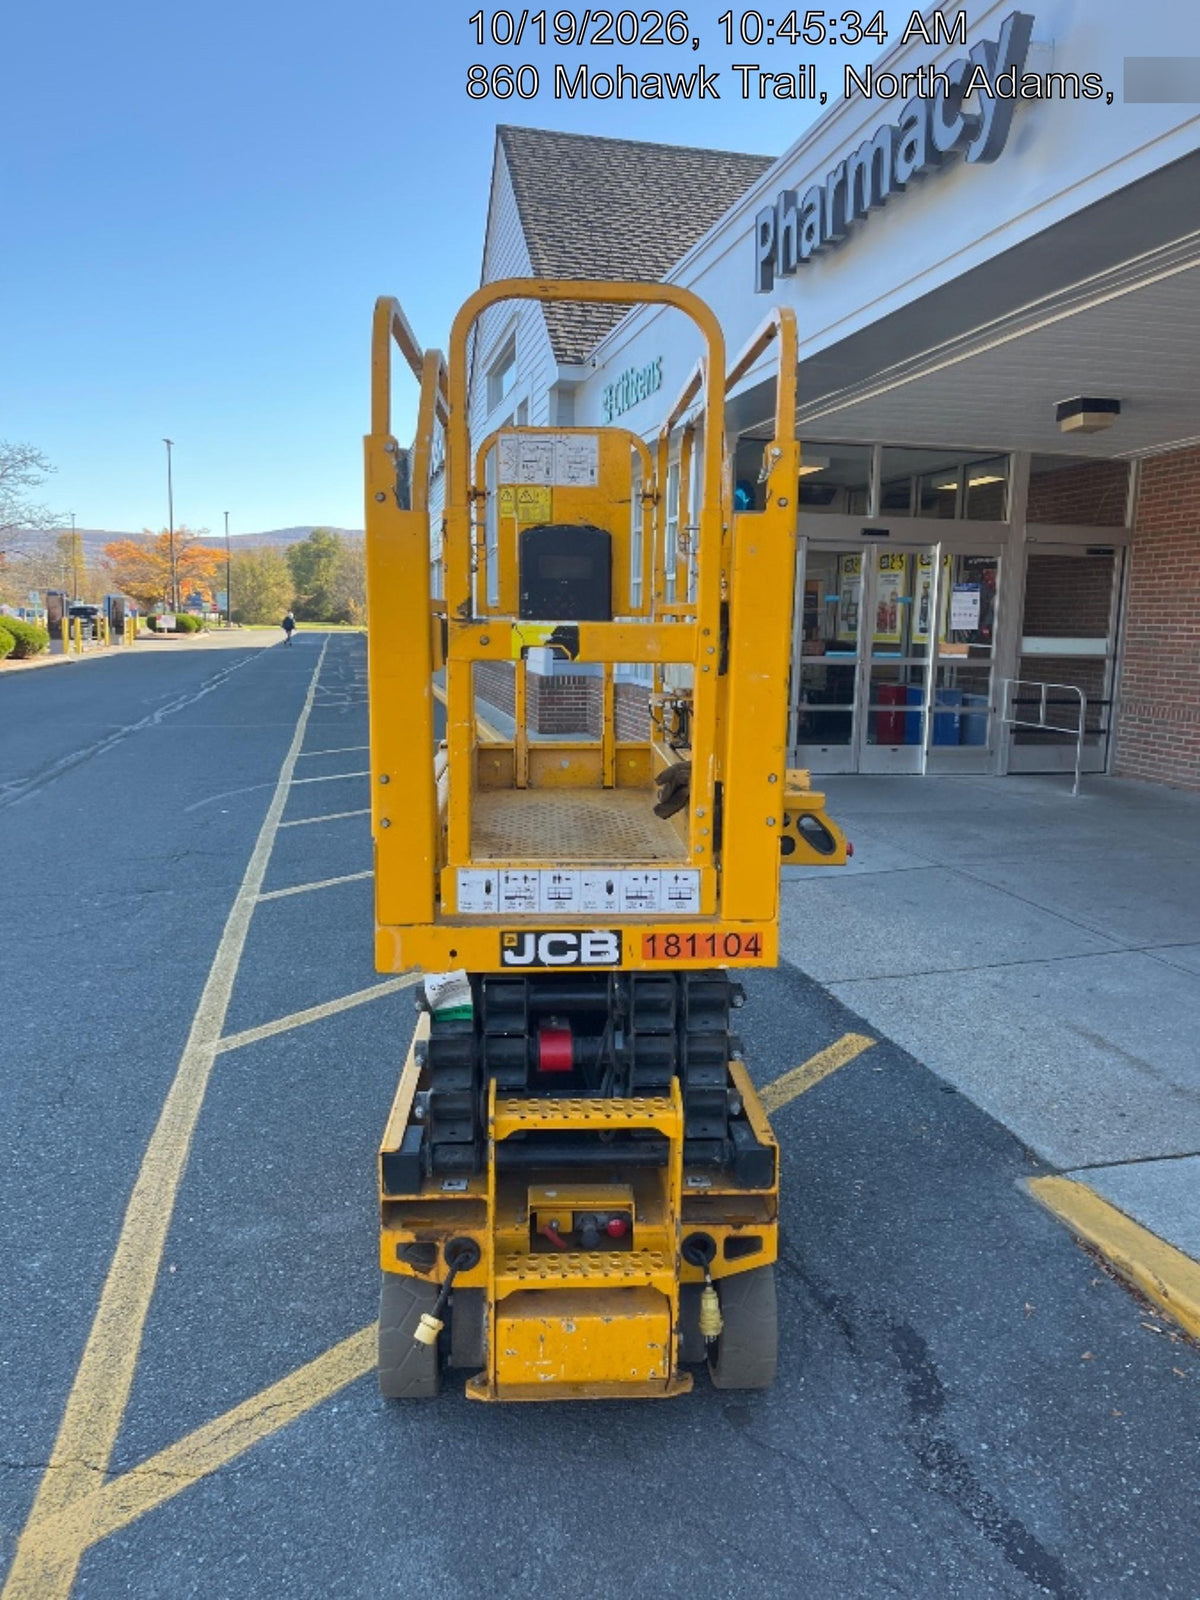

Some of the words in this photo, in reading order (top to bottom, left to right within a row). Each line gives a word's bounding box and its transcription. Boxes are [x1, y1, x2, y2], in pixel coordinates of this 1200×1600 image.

[754, 10, 1035, 294] Pharmacy
[503, 931, 620, 966] JCB
[645, 933, 762, 958] 181104
